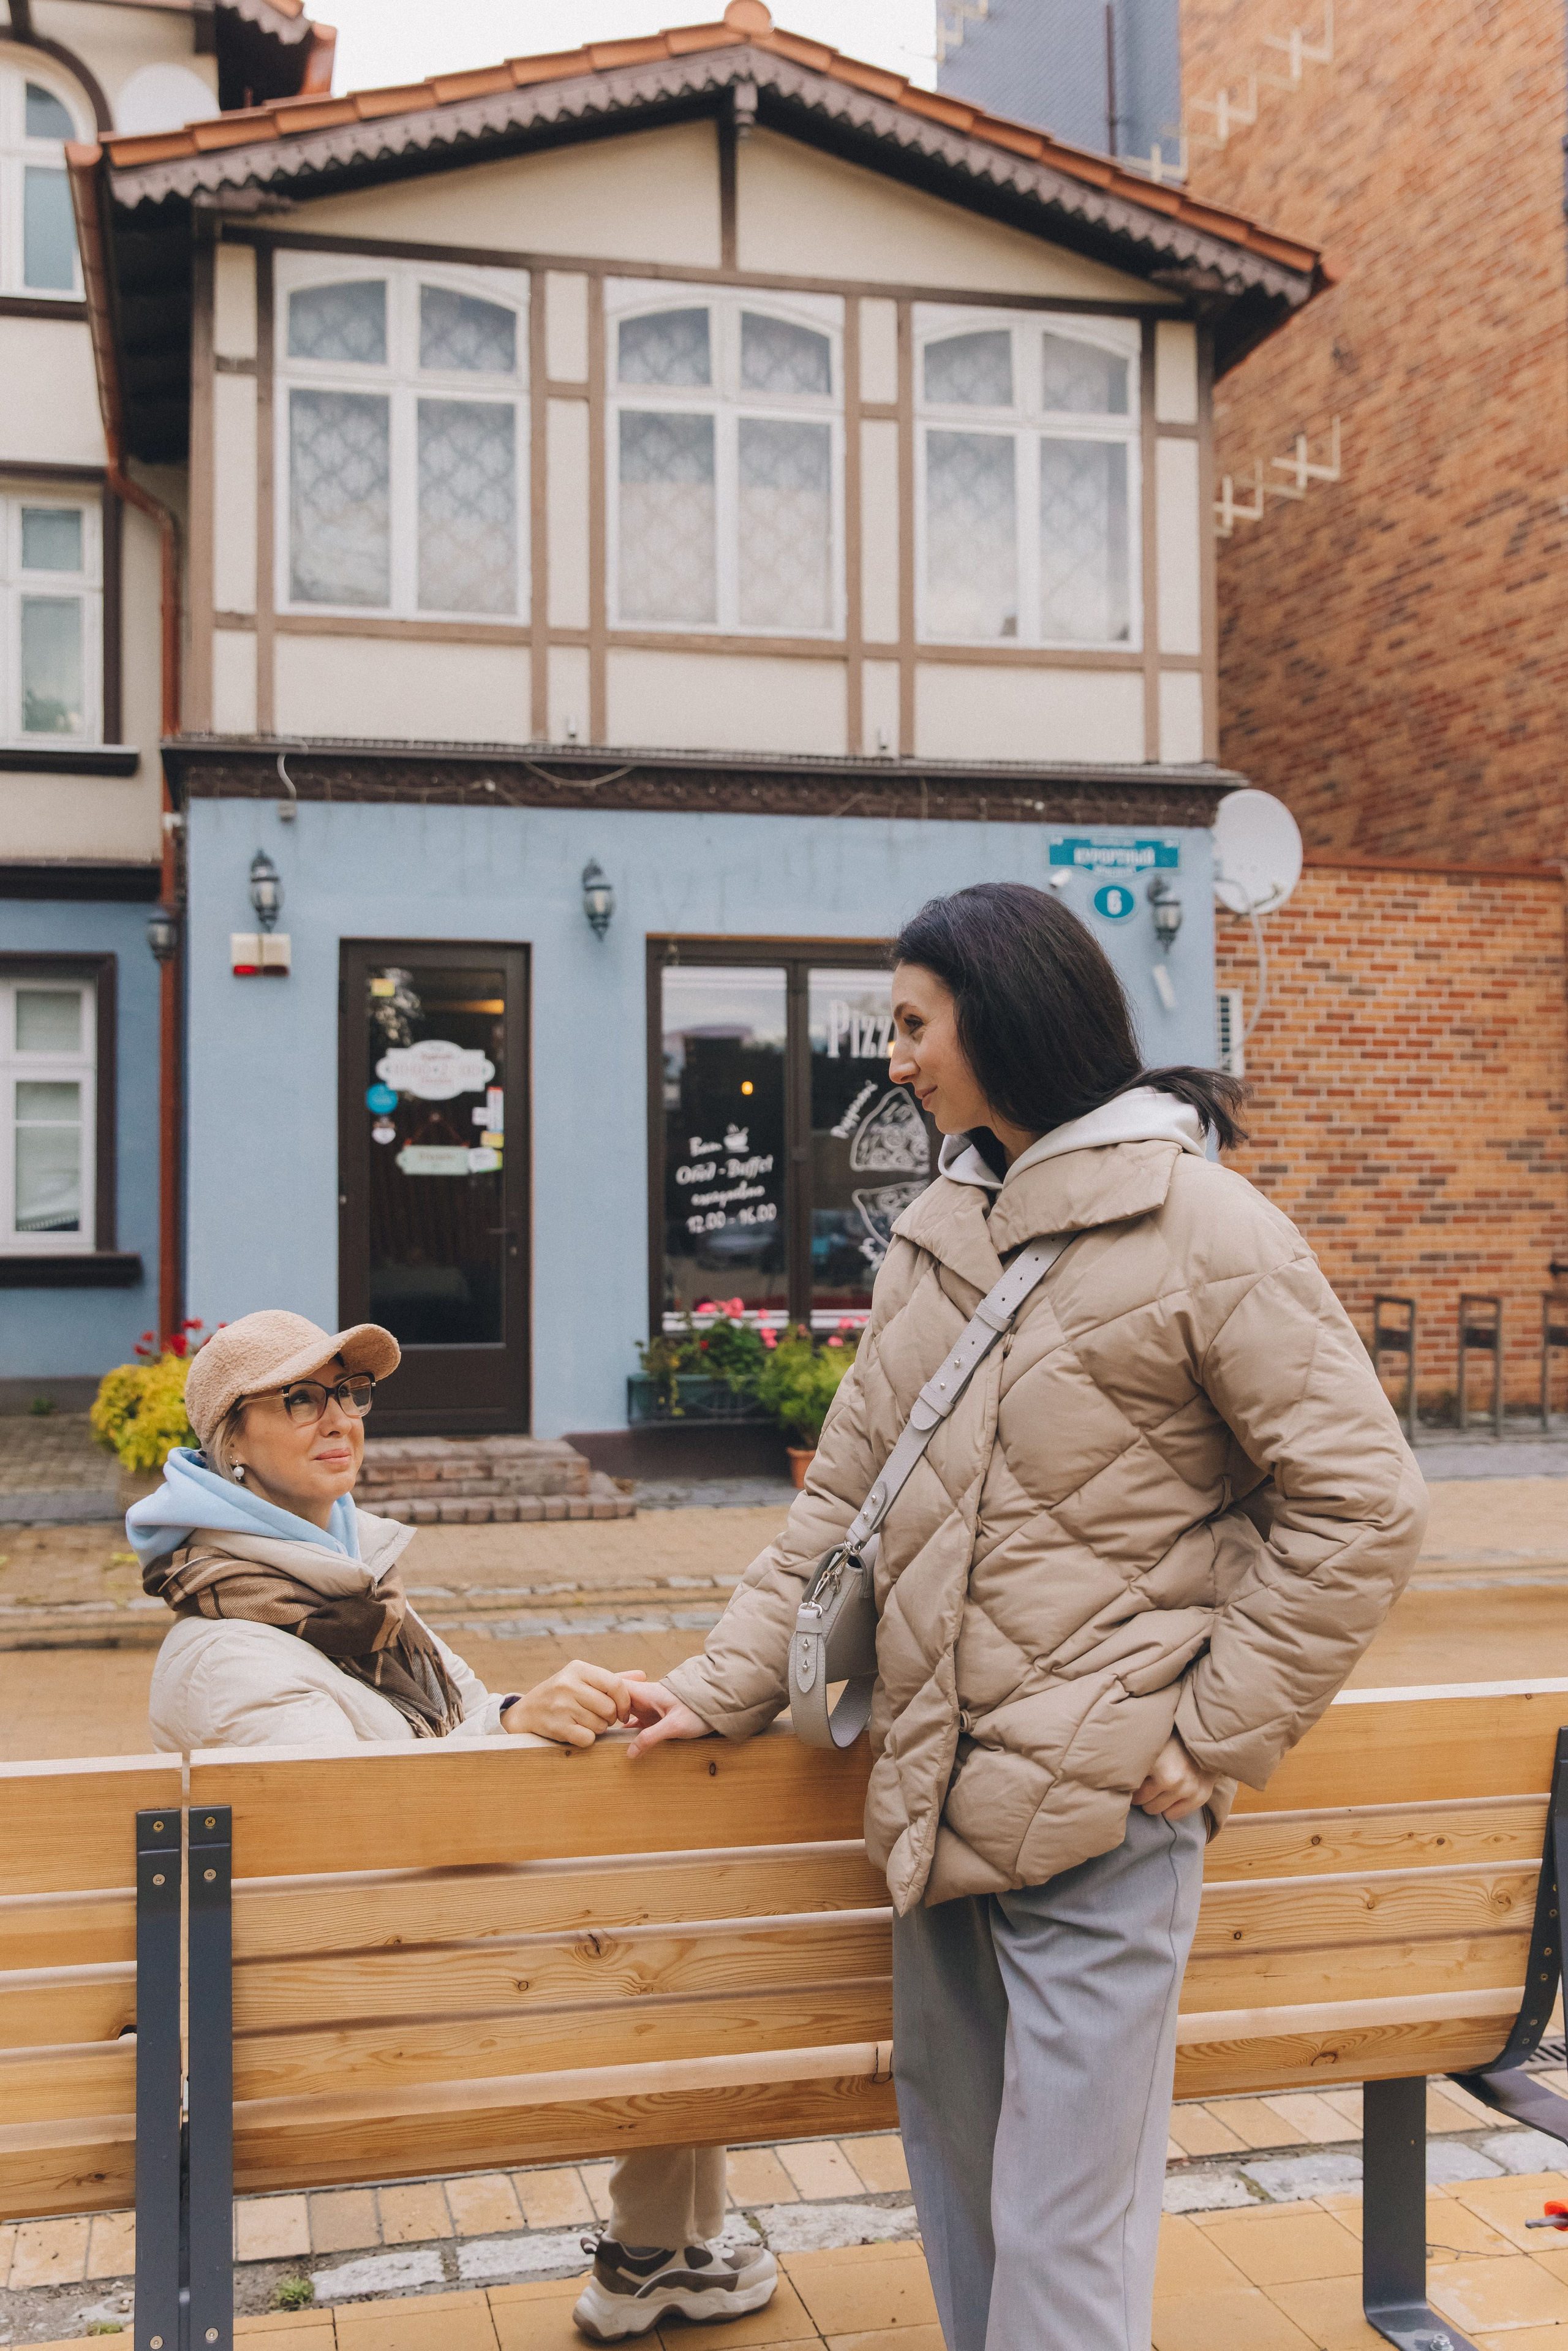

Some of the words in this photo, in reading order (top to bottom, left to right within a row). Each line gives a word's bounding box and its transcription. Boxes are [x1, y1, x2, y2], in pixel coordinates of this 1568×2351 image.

[1074, 847, 1155, 866] КУРОРТНЫЙ
[1107, 889, 1122, 915] 6
[827, 1000, 892, 1058] PIZZ
[691, 1180, 765, 1209] ежедневно
